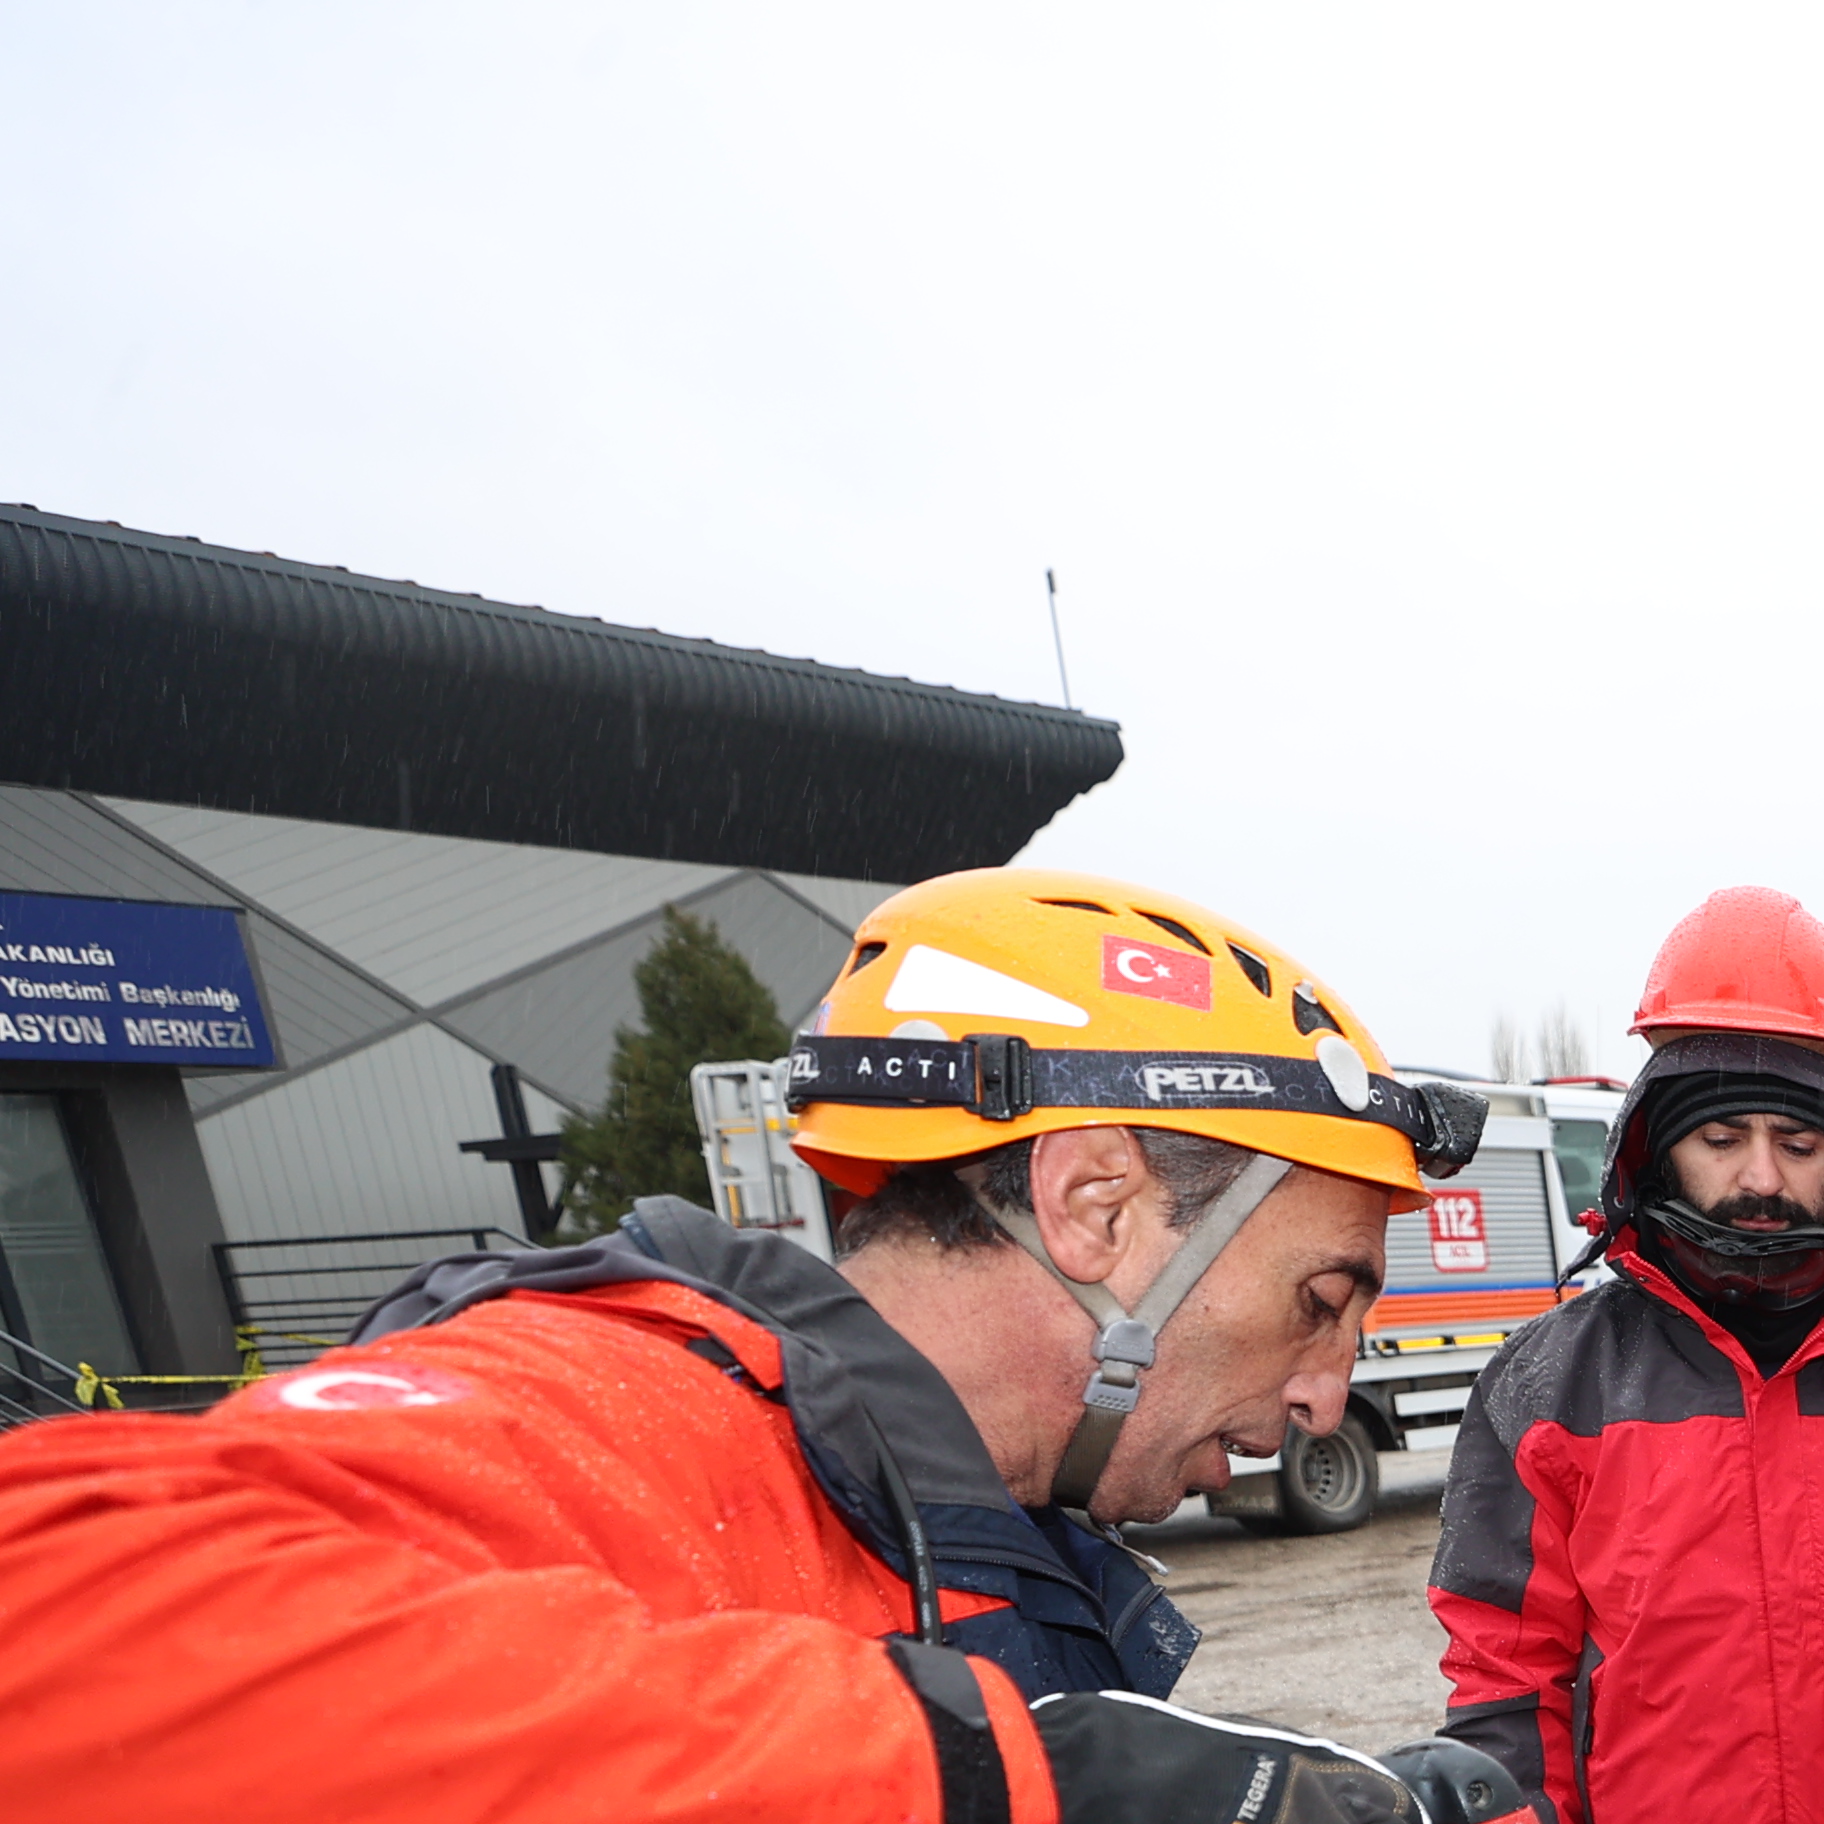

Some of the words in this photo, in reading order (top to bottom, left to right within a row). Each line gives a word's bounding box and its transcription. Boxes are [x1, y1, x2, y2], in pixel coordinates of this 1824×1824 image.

[0, 975, 112, 1002] Yönetimi
[118, 981, 240, 1013] Başkanlığı
[123, 1016, 256, 1049] MERKEZİ
[1143, 1066, 1277, 1102] PETZL
[1433, 1197, 1480, 1238] 112
